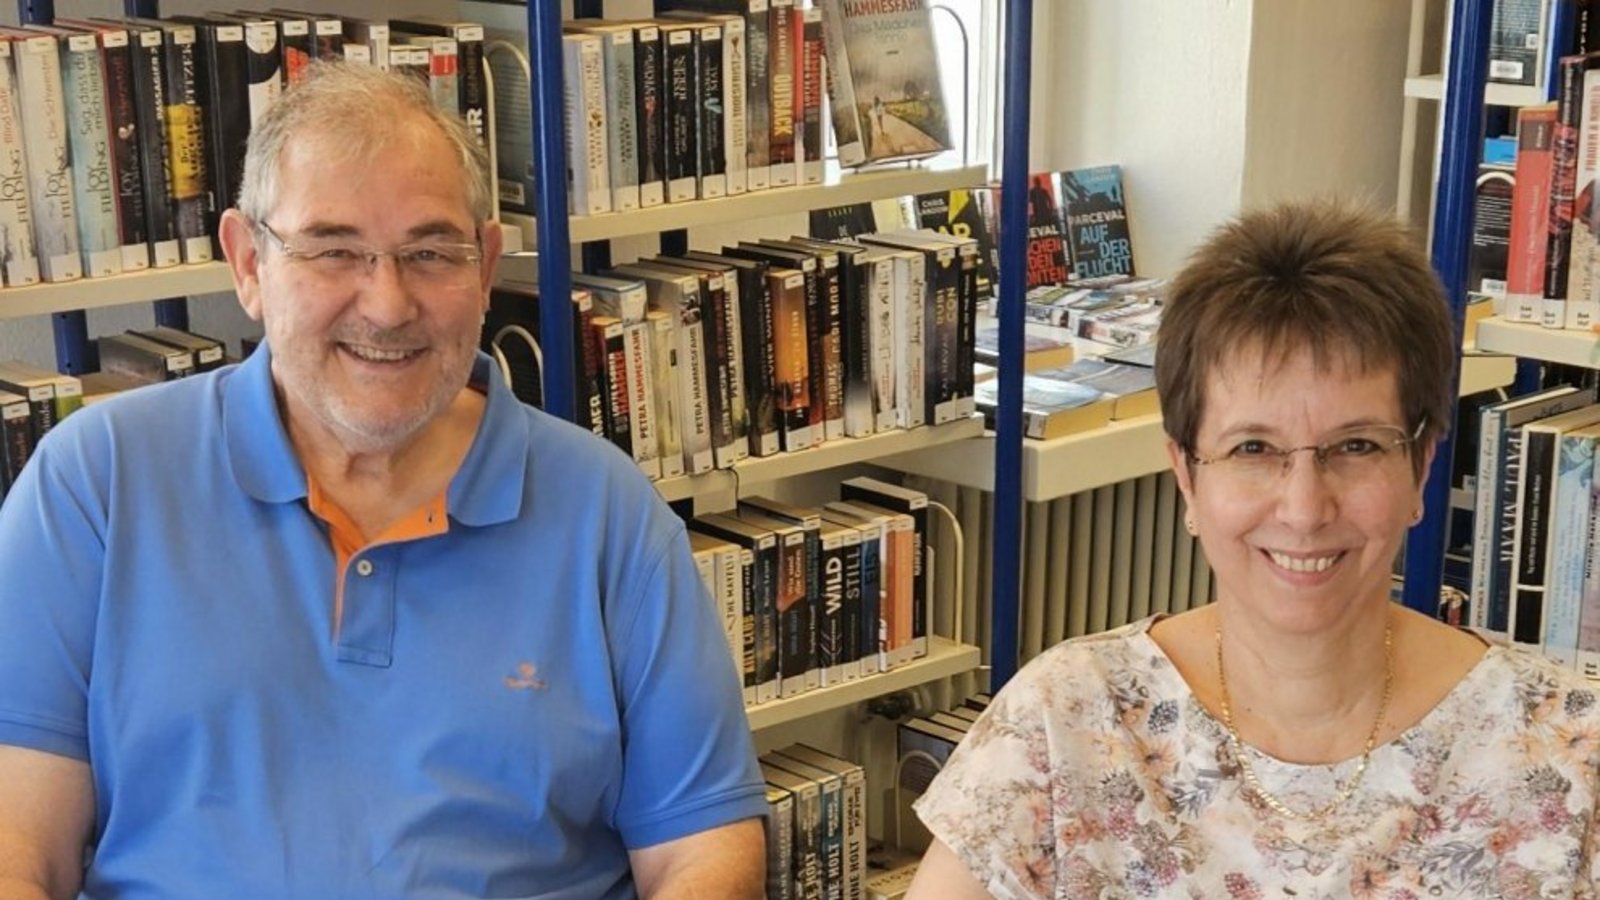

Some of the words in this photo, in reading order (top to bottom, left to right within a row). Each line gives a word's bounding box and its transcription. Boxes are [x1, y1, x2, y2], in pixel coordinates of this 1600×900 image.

[152, 59, 163, 120] PASSAGIER
[773, 74, 792, 136] OUTBACK
[11, 150, 28, 223] FIELDING
[54, 146, 71, 218] FIELDING
[96, 141, 112, 213] FIELDING
[1067, 208, 1127, 224] PARCEVAL
[1080, 223, 1108, 244] AUF
[1099, 238, 1130, 259] DER
[1075, 255, 1131, 280] FLUCHT
[829, 275, 840, 315] MORA
[936, 289, 945, 326] RUBI
[945, 286, 956, 323] CON
[725, 290, 737, 361] HAMMESFAHR
[631, 329, 644, 402] HAMMESFAHR
[689, 327, 702, 399] HAMMESFAHR
[728, 366, 738, 398] PETRA
[828, 363, 838, 407] THOMAS
[638, 404, 648, 439] PETRA
[695, 402, 704, 435] PETRA
[824, 557, 842, 615] WILD
[846, 547, 860, 599] STILL
[865, 552, 877, 584] EIS
[726, 600, 735, 618] THE
[805, 852, 816, 885] HOLT
[828, 843, 839, 878] HOLT
[849, 841, 859, 872] HOLT
